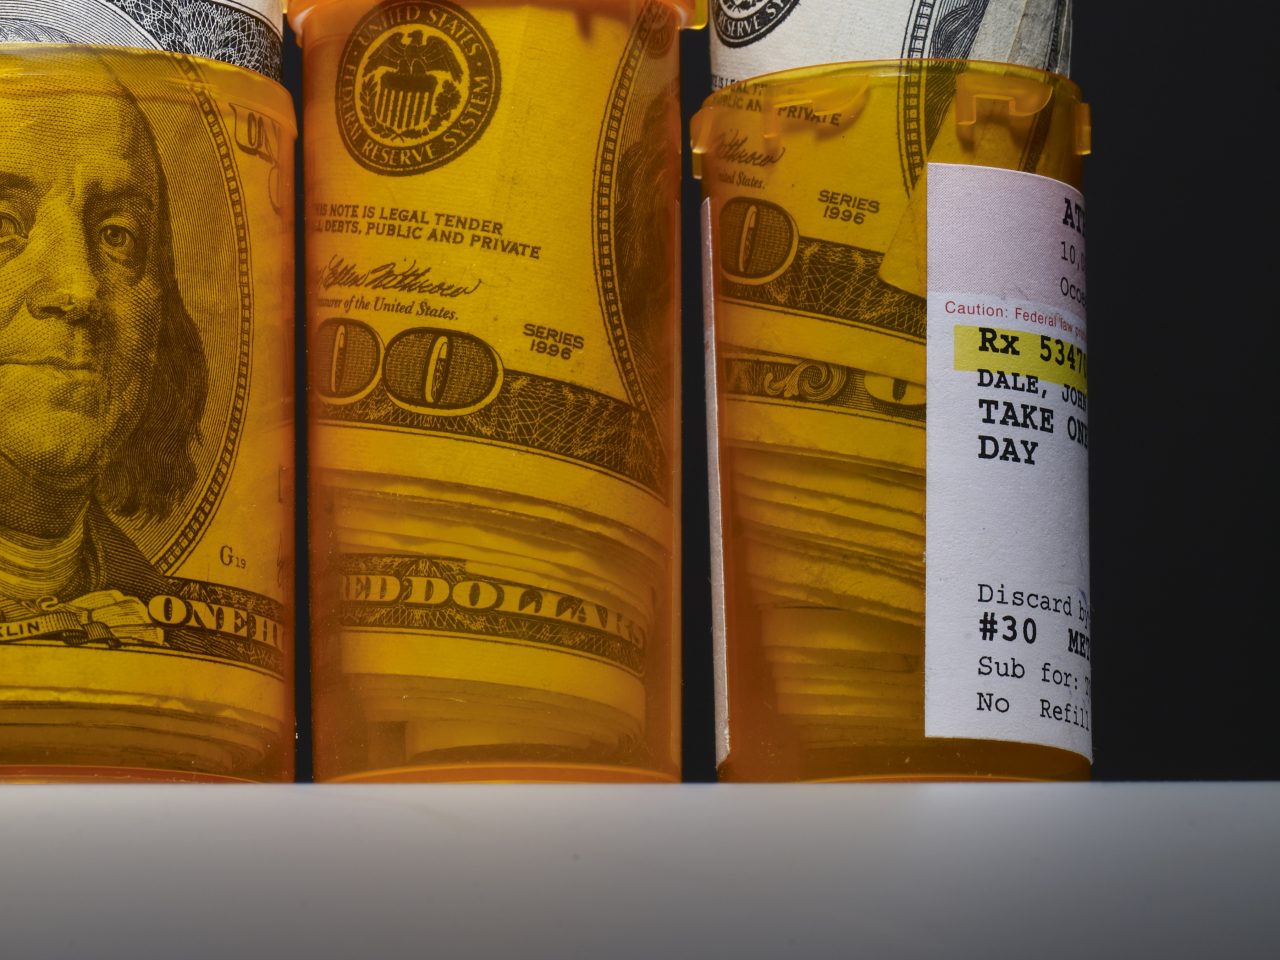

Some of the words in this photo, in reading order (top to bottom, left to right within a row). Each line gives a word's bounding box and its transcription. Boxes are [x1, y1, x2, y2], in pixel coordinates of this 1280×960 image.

[359, 5, 420, 45] UNITED
[427, 8, 482, 57] STATES
[362, 141, 435, 165] RESERVE
[443, 76, 490, 148] SYSTEM
[736, 172, 765, 189] States.
[818, 190, 880, 214] SERIES
[823, 205, 866, 225] 1996
[1063, 197, 1086, 236] AT
[313, 204, 327, 217] HIS
[329, 204, 359, 217] NOTE
[362, 206, 375, 218] IS
[380, 208, 430, 225] LEGAL
[434, 212, 504, 236] TENDER
[324, 219, 362, 235] DEBTS,
[366, 222, 422, 240] PUBLIC
[426, 228, 465, 245] AND
[469, 235, 542, 260] PRIVATE
[343, 296, 354, 313] of
[354, 297, 371, 311] the
[374, 296, 415, 315] United
[416, 303, 459, 322] States.
[945, 301, 1008, 318] Caution:
[1015, 307, 1057, 327] Federal
[522, 323, 585, 350] SERIES
[529, 339, 574, 361] 1996
[978, 327, 1020, 356] Rx
[977, 369, 1047, 398] DALE,
[978, 399, 1054, 433] TAKE
[977, 435, 1039, 465] DAY
[977, 583, 1072, 617] Discard
[148, 595, 248, 640] ONE
[979, 612, 1037, 644] #30
[978, 656, 1025, 678] Sub
[1041, 663, 1078, 690] for:
[977, 692, 1010, 713] No
